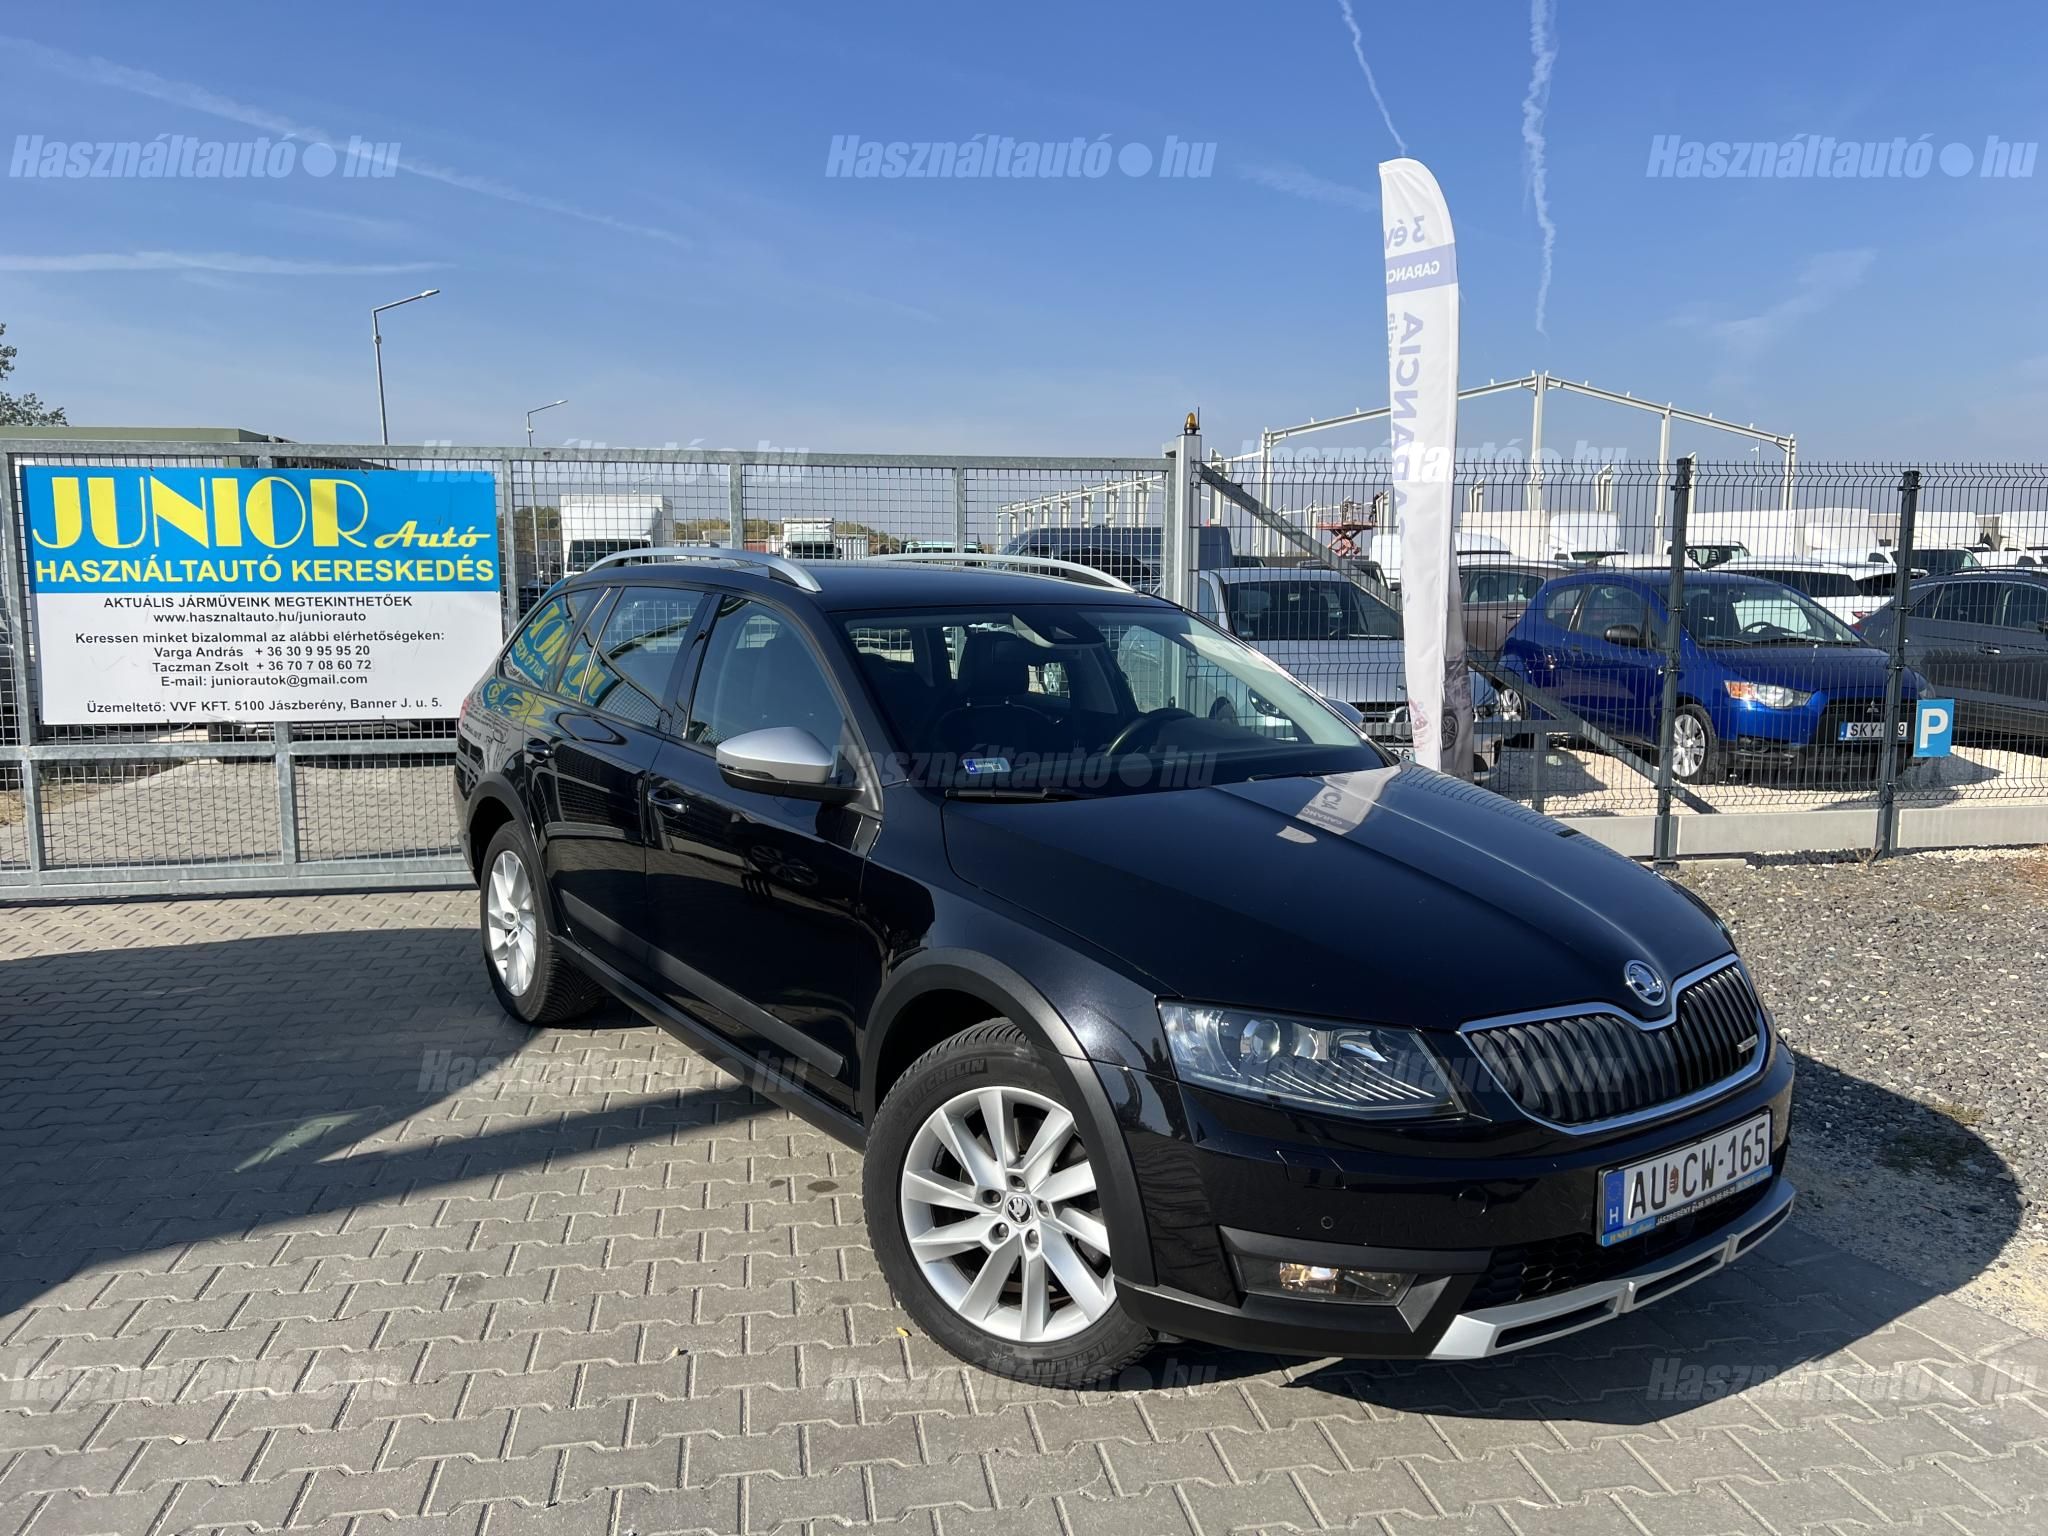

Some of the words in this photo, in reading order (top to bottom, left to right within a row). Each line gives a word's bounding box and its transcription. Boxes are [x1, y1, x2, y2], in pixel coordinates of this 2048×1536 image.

[33, 476, 368, 549] JUNIOR
[374, 520, 491, 549] Autó
[36, 554, 282, 583] HASZNÁLTAUTÓ
[292, 554, 494, 582] KERESKEDÉS
[104, 595, 174, 608] AKTUÁLIS
[153, 612, 367, 625] www.hasznaltauto.hu/juniorauto
[75, 633, 139, 644] Keressen
[143, 632, 188, 643] minket
[191, 632, 267, 643] bizalommal
[271, 633, 286, 642] az
[289, 631, 329, 642] alábbi
[154, 647, 192, 659] Varga
[196, 646, 244, 657] András
[255, 648, 263, 656] +
[267, 646, 282, 656] 36
[286, 646, 301, 656] 30
[305, 646, 313, 656] 9
[316, 646, 332, 656] 95
[336, 645, 352, 656] 95
[355, 645, 370, 655] 20
[152, 661, 211, 672] Taczman
[215, 660, 249, 672] Zsolt
[256, 662, 264, 670] +
[268, 661, 283, 670] 36
[287, 660, 303, 670] 70
[307, 660, 314, 670] 7
[318, 660, 333, 670] 08
[337, 660, 352, 670] 60
[356, 659, 372, 670] 72
[161, 676, 207, 687] E-mail:
[211, 674, 368, 688] juniorautok@gmail.com
[170, 702, 197, 712] VVF
[201, 702, 231, 712] KFT.
[234, 701, 264, 711] 5100
[268, 700, 346, 711] Jászberény,
[351, 698, 397, 709] Banner
[401, 698, 412, 708] J.
[415, 699, 427, 708] u.
[431, 697, 442, 707] 5.
[1850, 723, 1905, 737] SKY-9
[1919, 708, 1949, 749] P
[1627, 1162, 1669, 1220] AU
[1682, 1122, 1766, 1198] CW-165
[1609, 1206, 1619, 1224] H
